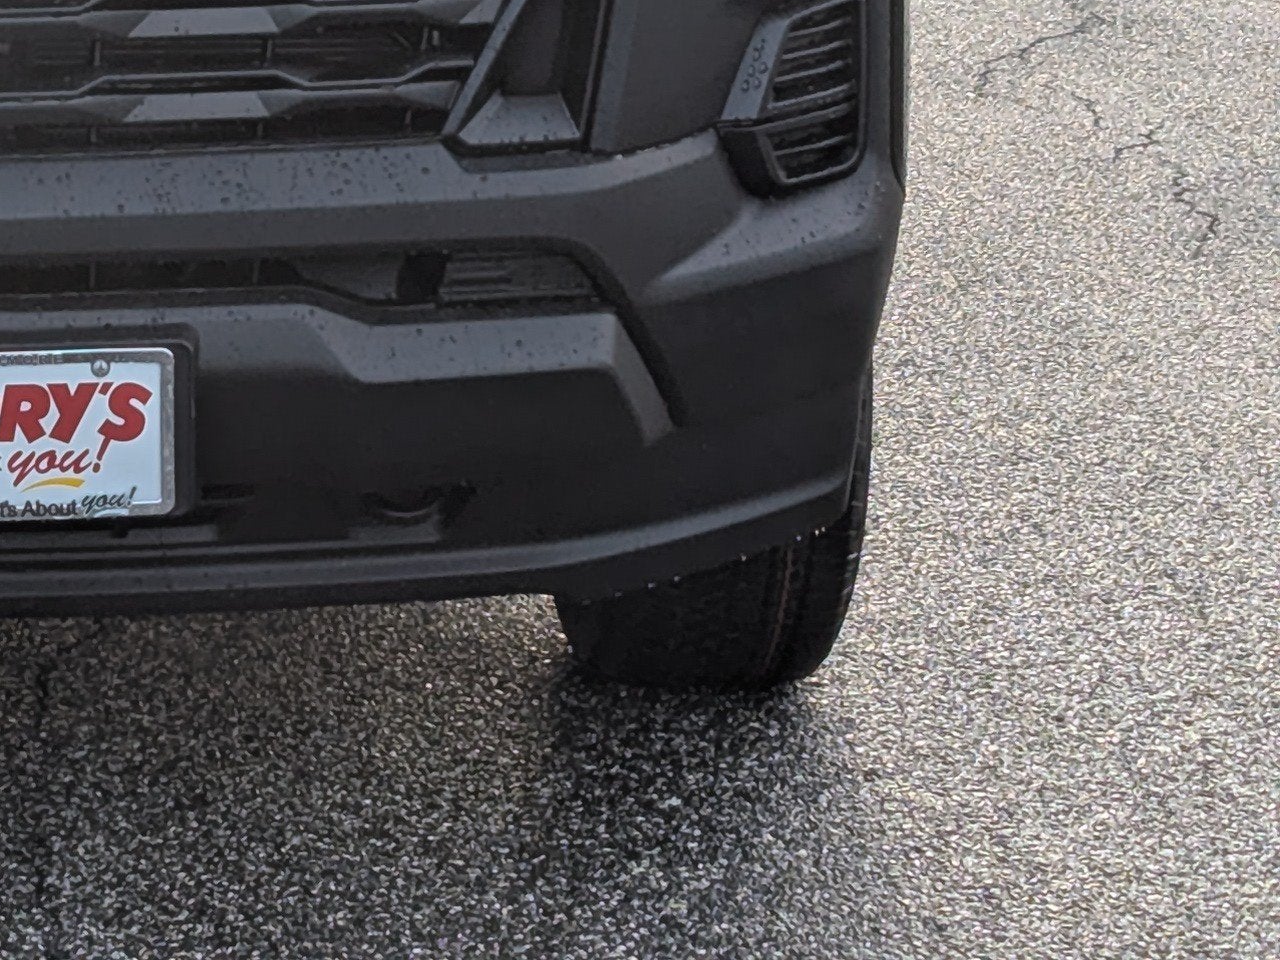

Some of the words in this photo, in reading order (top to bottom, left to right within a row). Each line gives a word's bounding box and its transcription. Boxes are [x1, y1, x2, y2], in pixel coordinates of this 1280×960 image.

[6, 435, 111, 487] you!
[21, 499, 79, 518] About
[81, 486, 138, 511] you!
